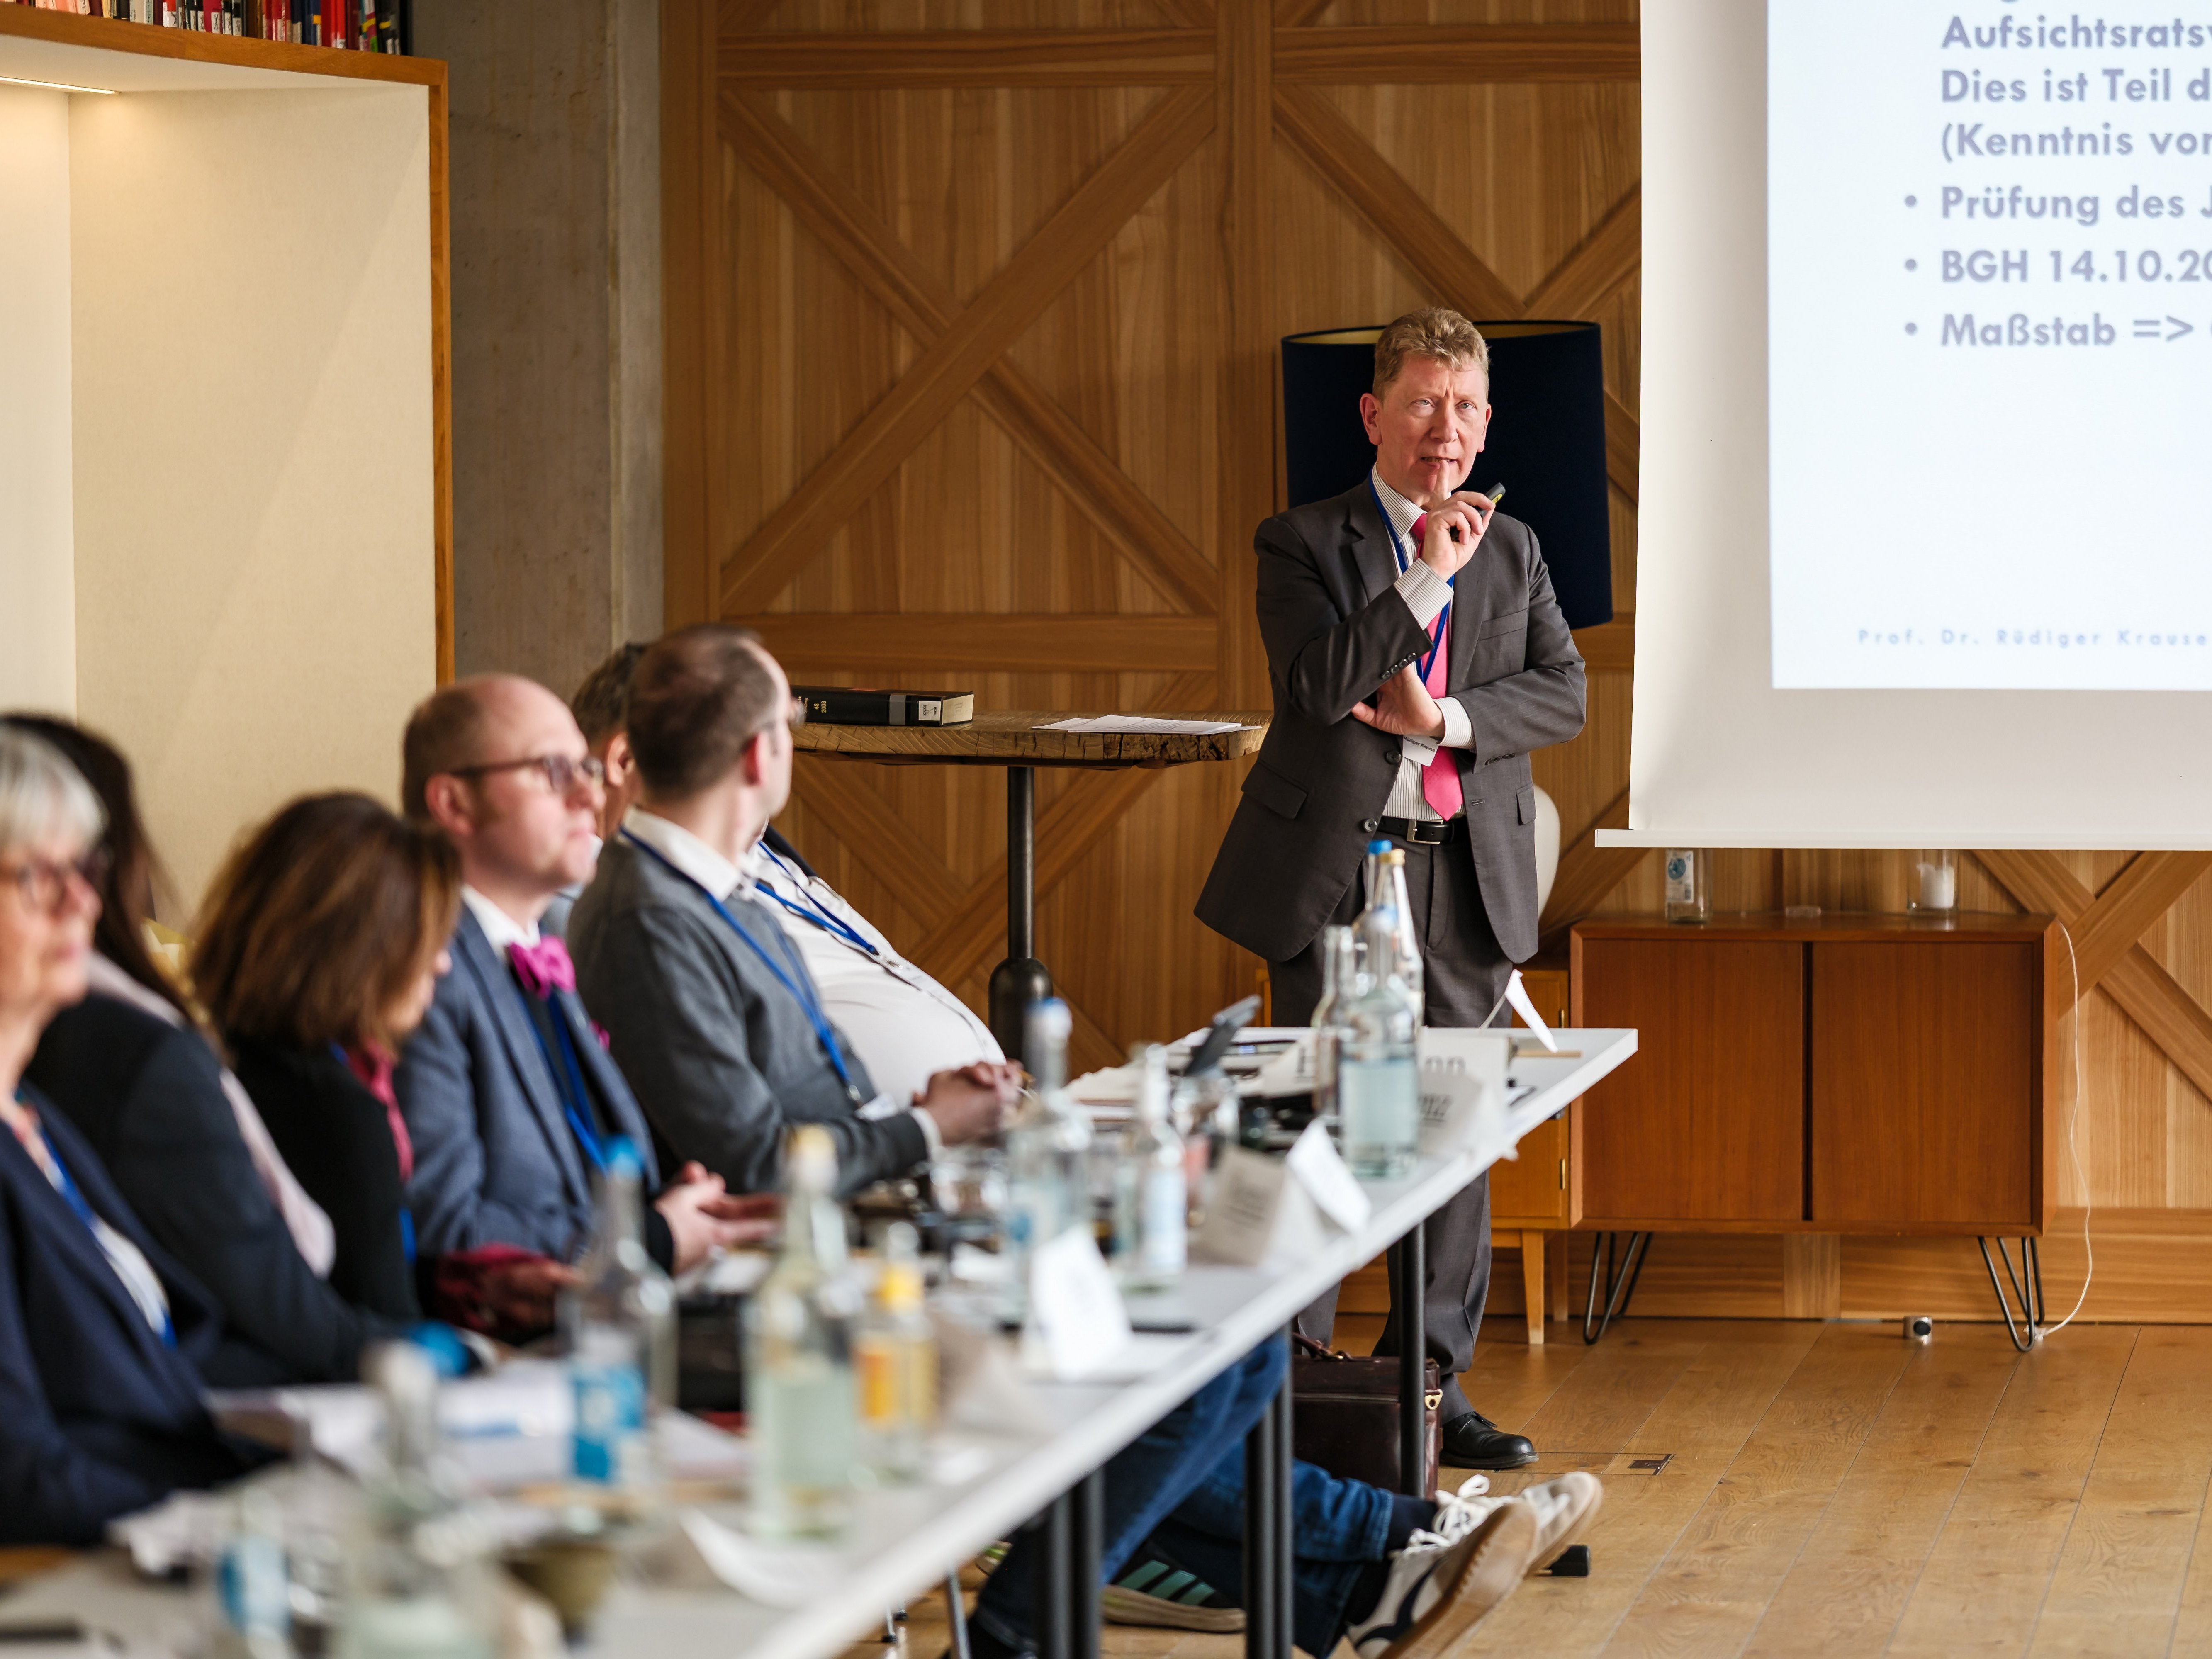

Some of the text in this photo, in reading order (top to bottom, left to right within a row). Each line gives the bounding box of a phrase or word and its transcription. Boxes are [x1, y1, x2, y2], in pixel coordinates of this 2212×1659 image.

[1941, 14, 2212, 49] Aufsichtsrats
[1942, 68, 2027, 102] Dies
[2043, 68, 2088, 102] ist
[2102, 67, 2171, 102] Teil
[1942, 122, 2133, 163] (Kenntnis
[1942, 185, 2099, 227] Prüfung
[2116, 184, 2185, 219] des
[1942, 249, 2028, 283] BGH
[1941, 313, 2116, 346] Maßstab
[1858, 628, 2208, 649] Prof. Dr. Rüdiger Krause
